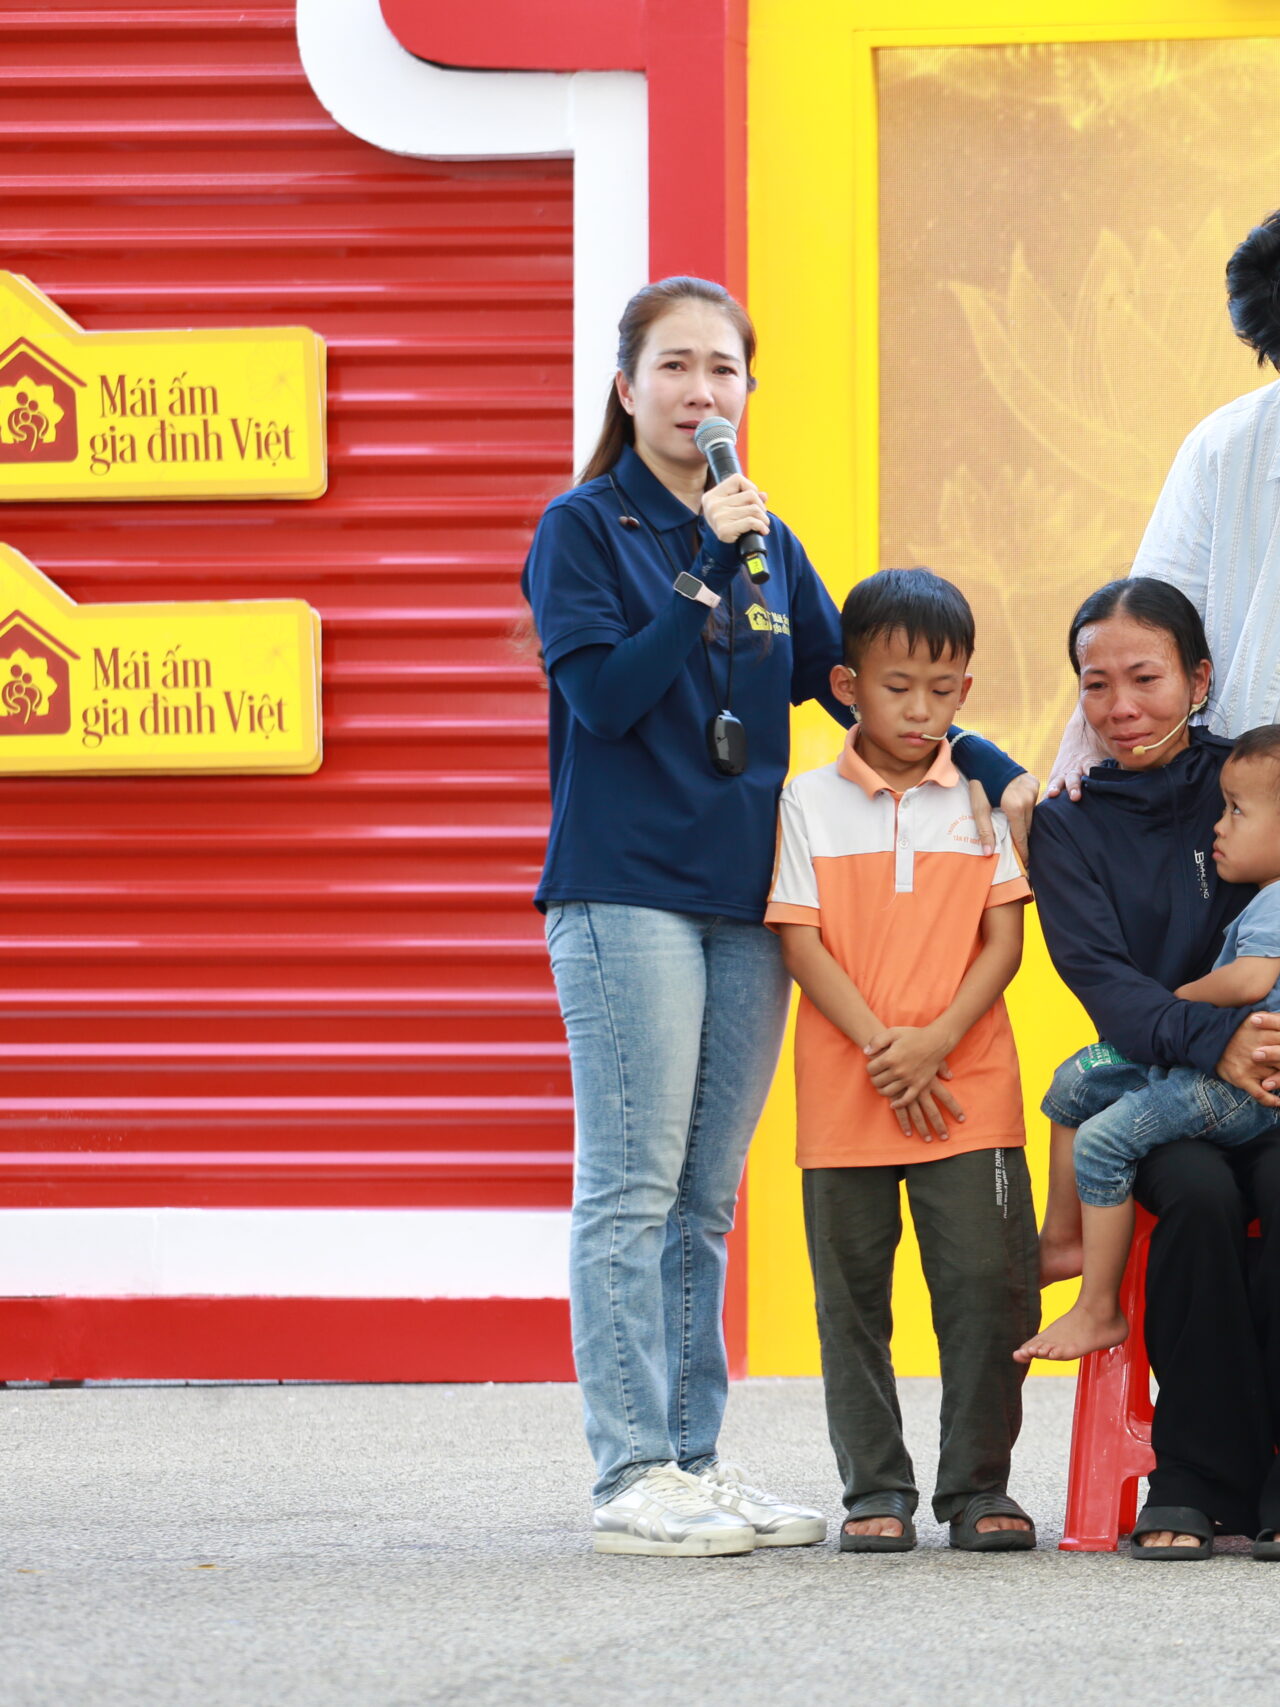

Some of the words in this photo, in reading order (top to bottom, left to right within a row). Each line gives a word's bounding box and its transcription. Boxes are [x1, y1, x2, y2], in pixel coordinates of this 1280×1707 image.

[99, 374, 158, 418] Mái
[168, 371, 220, 416] ấm
[89, 425, 137, 475] gia
[147, 417, 224, 463] đình
[231, 418, 296, 466] Việt
[92, 647, 152, 691] Mái
[161, 644, 213, 689] ấm
[81, 698, 129, 747] gia
[139, 691, 216, 736] đình
[223, 690, 288, 739] Việt
